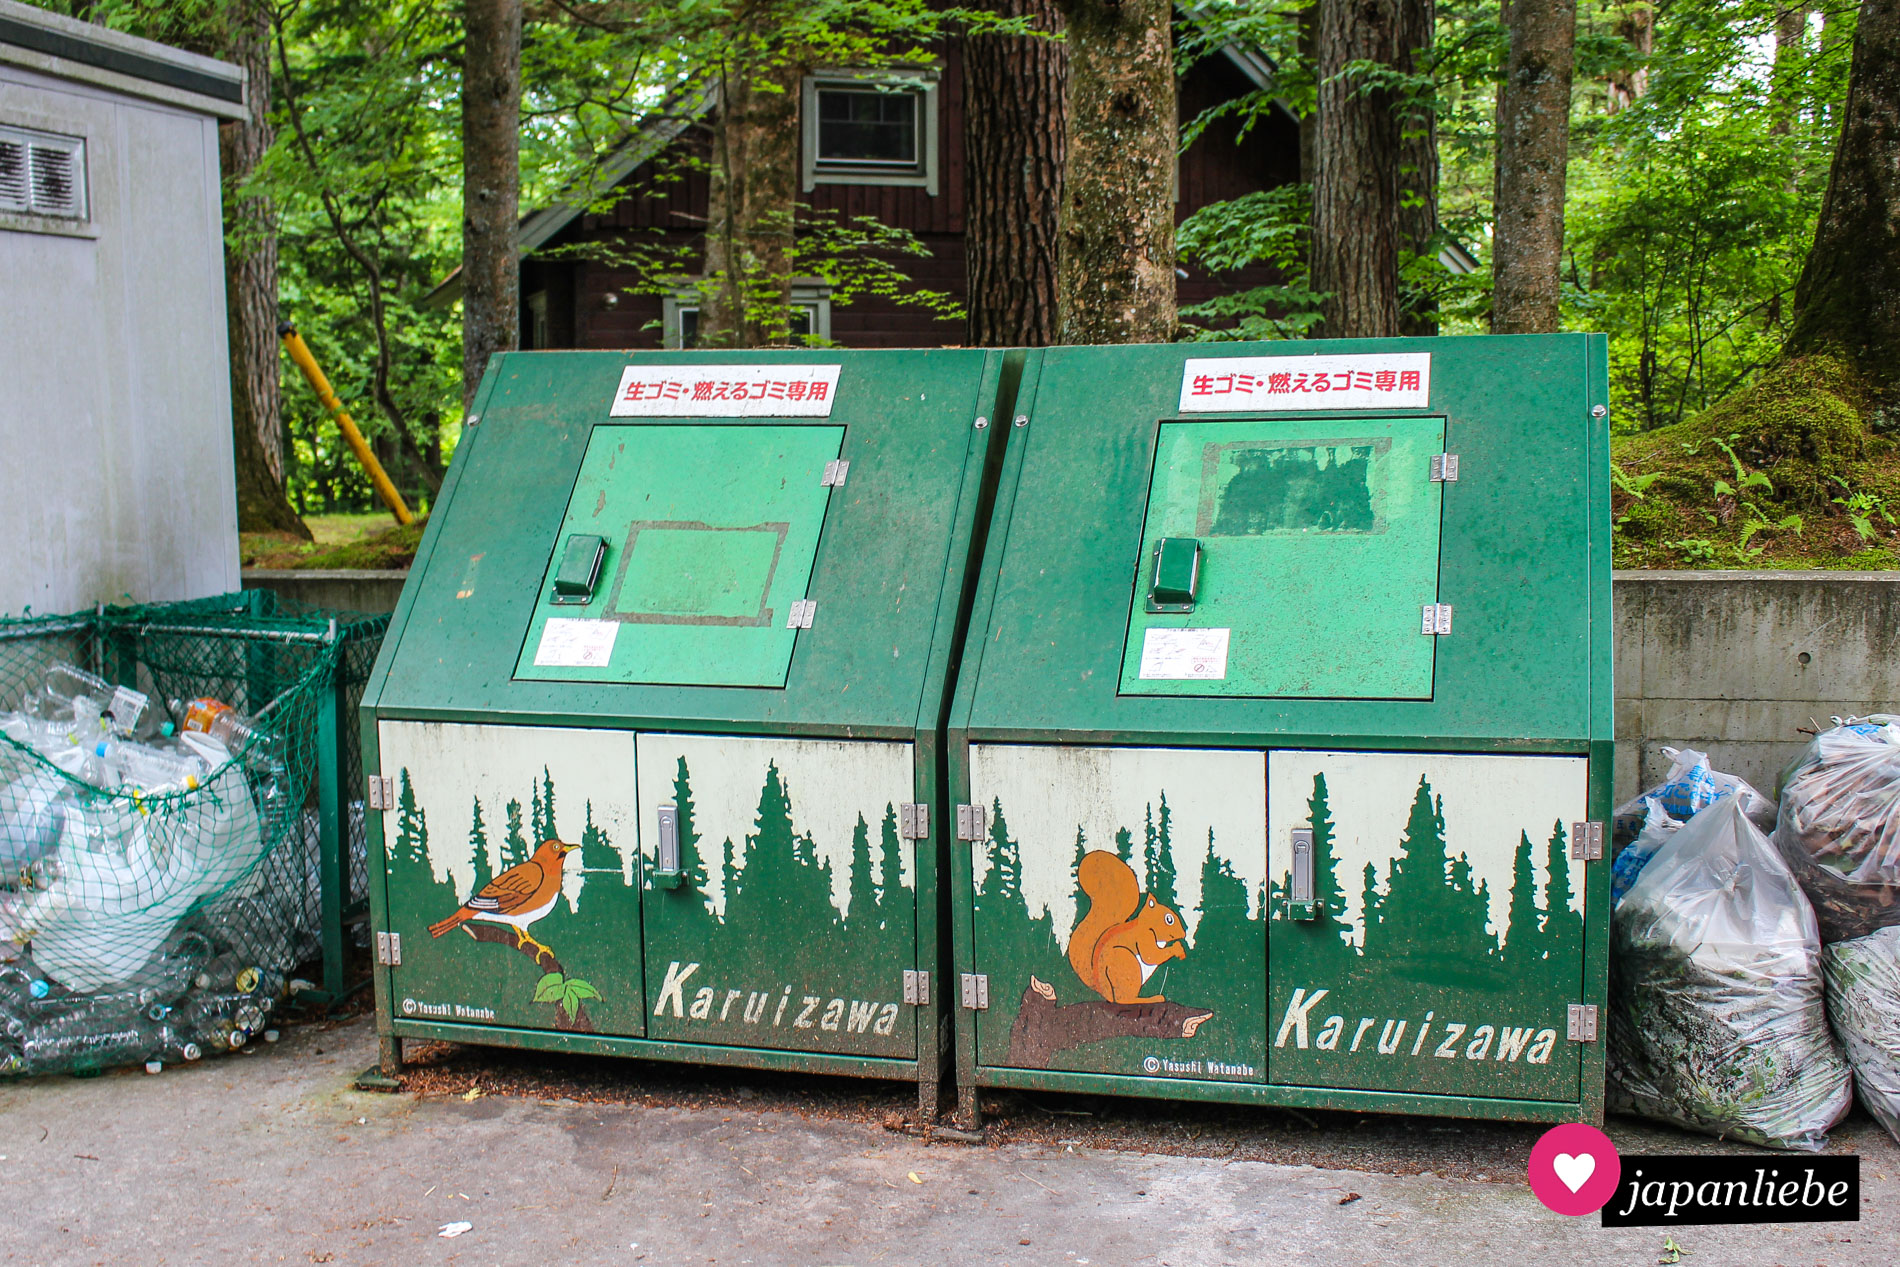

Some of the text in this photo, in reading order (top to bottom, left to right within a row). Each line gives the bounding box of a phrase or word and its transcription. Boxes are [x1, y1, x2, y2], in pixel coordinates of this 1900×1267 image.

[623, 380, 829, 401] 生ゴミ・燃えるゴミ専用
[1191, 370, 1421, 396] 生ゴミ・燃えるゴミ専用
[653, 961, 899, 1036] Karuizawa
[455, 1004, 495, 1019] Watanabe
[1274, 988, 1557, 1064] Karuizawa
[1207, 1061, 1254, 1076] Watanabe
